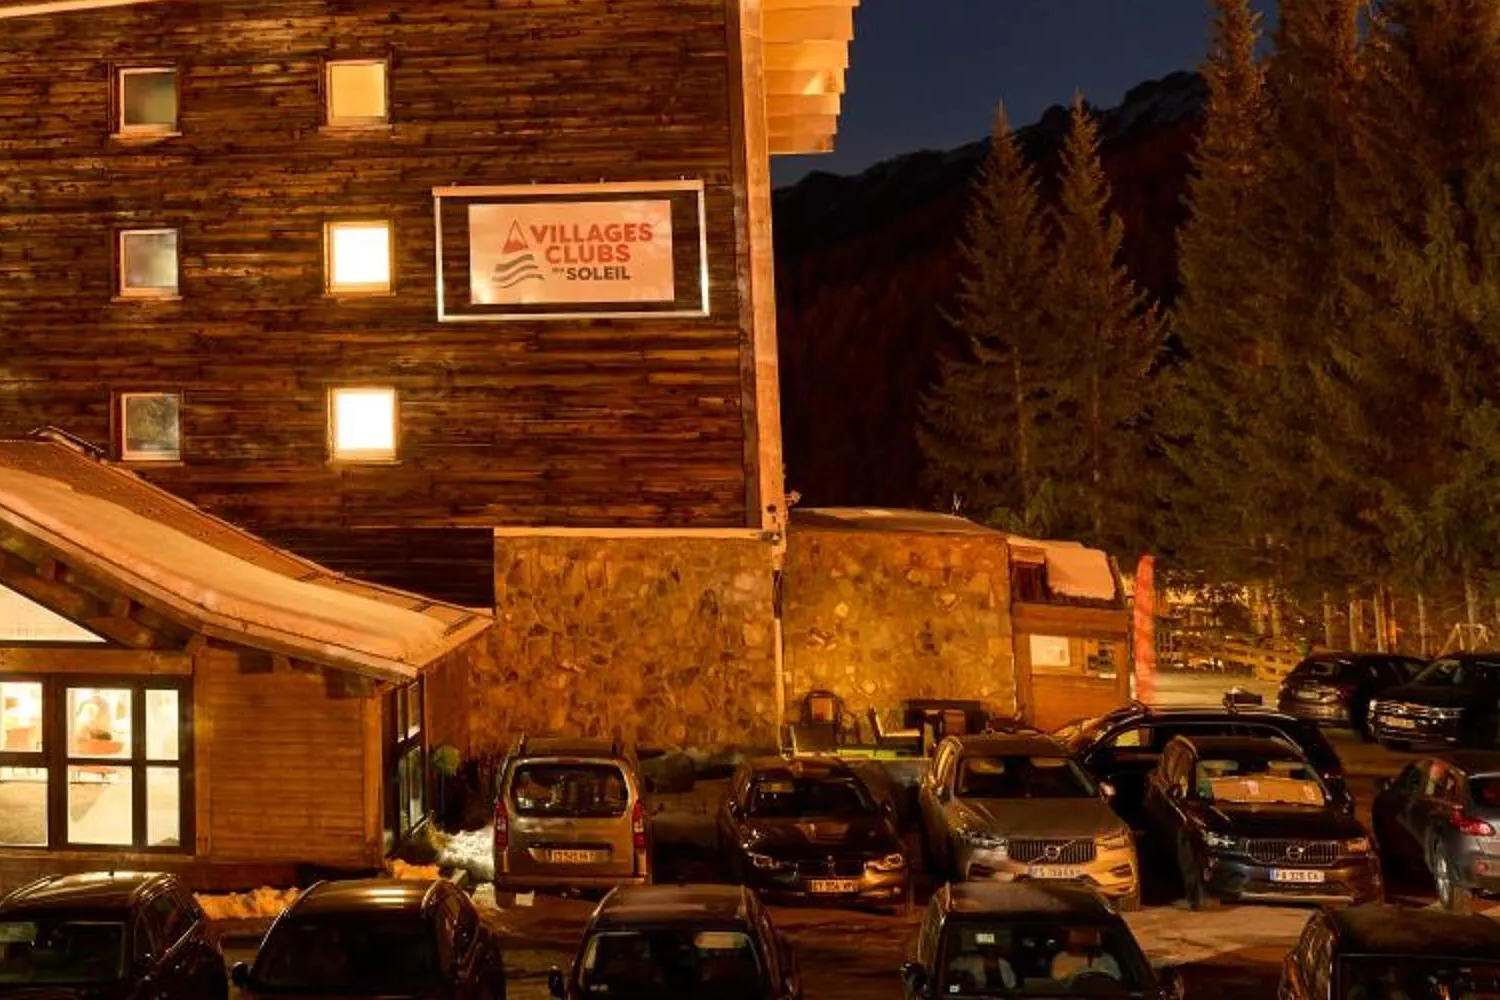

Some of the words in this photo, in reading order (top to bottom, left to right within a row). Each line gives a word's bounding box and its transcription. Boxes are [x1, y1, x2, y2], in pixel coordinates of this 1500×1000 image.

[529, 223, 653, 243] VILLAGES
[545, 244, 631, 264] CLUBS
[566, 266, 631, 281] SOLEIL
